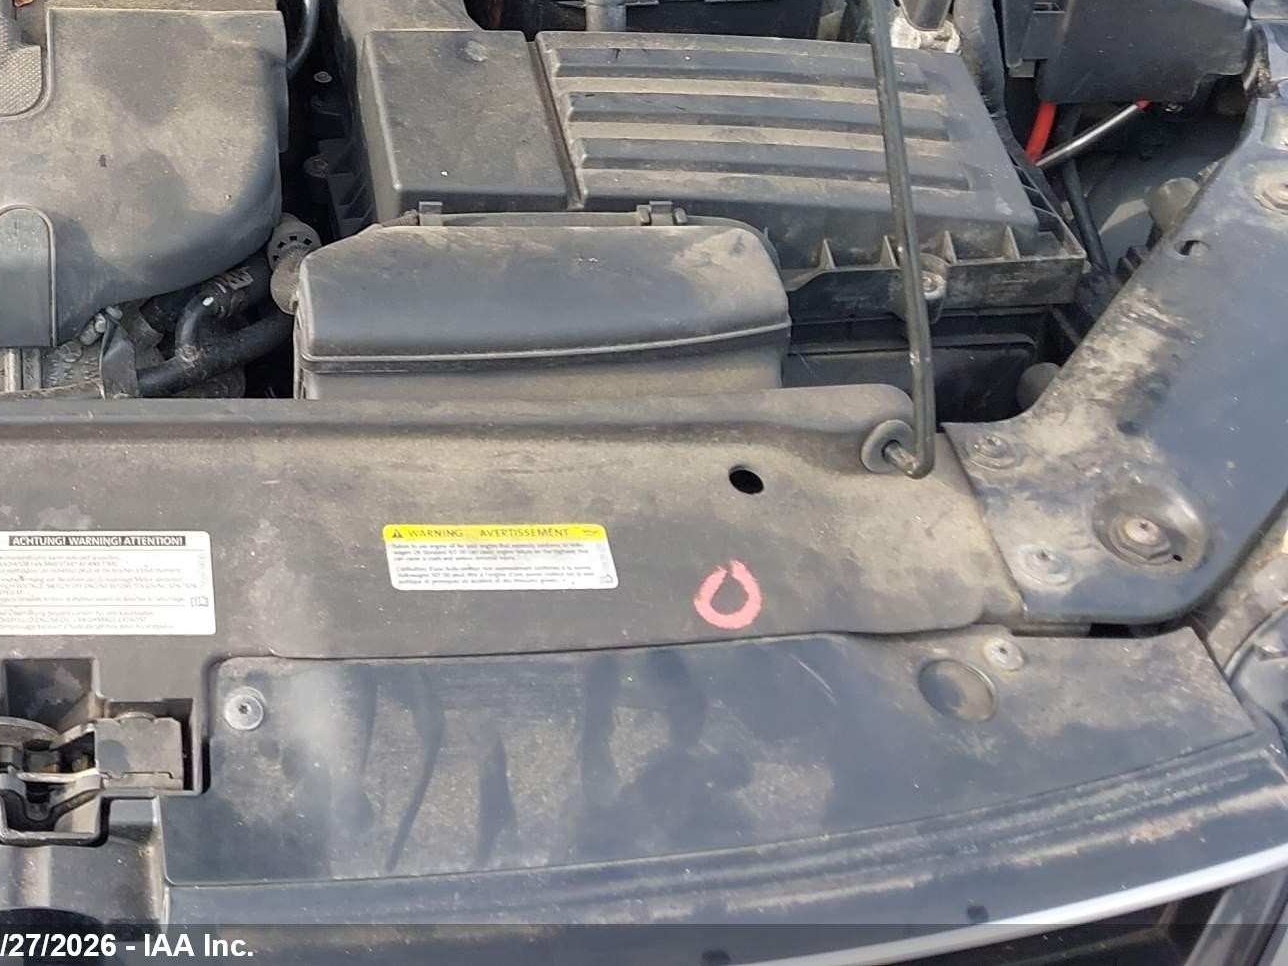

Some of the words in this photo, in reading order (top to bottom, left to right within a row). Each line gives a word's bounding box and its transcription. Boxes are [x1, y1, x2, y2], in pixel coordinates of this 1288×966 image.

[407, 529, 464, 538] WARNING
[479, 528, 569, 538] AVERTISSEMENT
[12, 535, 66, 546] ACHTUNG!
[68, 535, 122, 546] WARNING!
[123, 535, 185, 546] ATTENTION!
